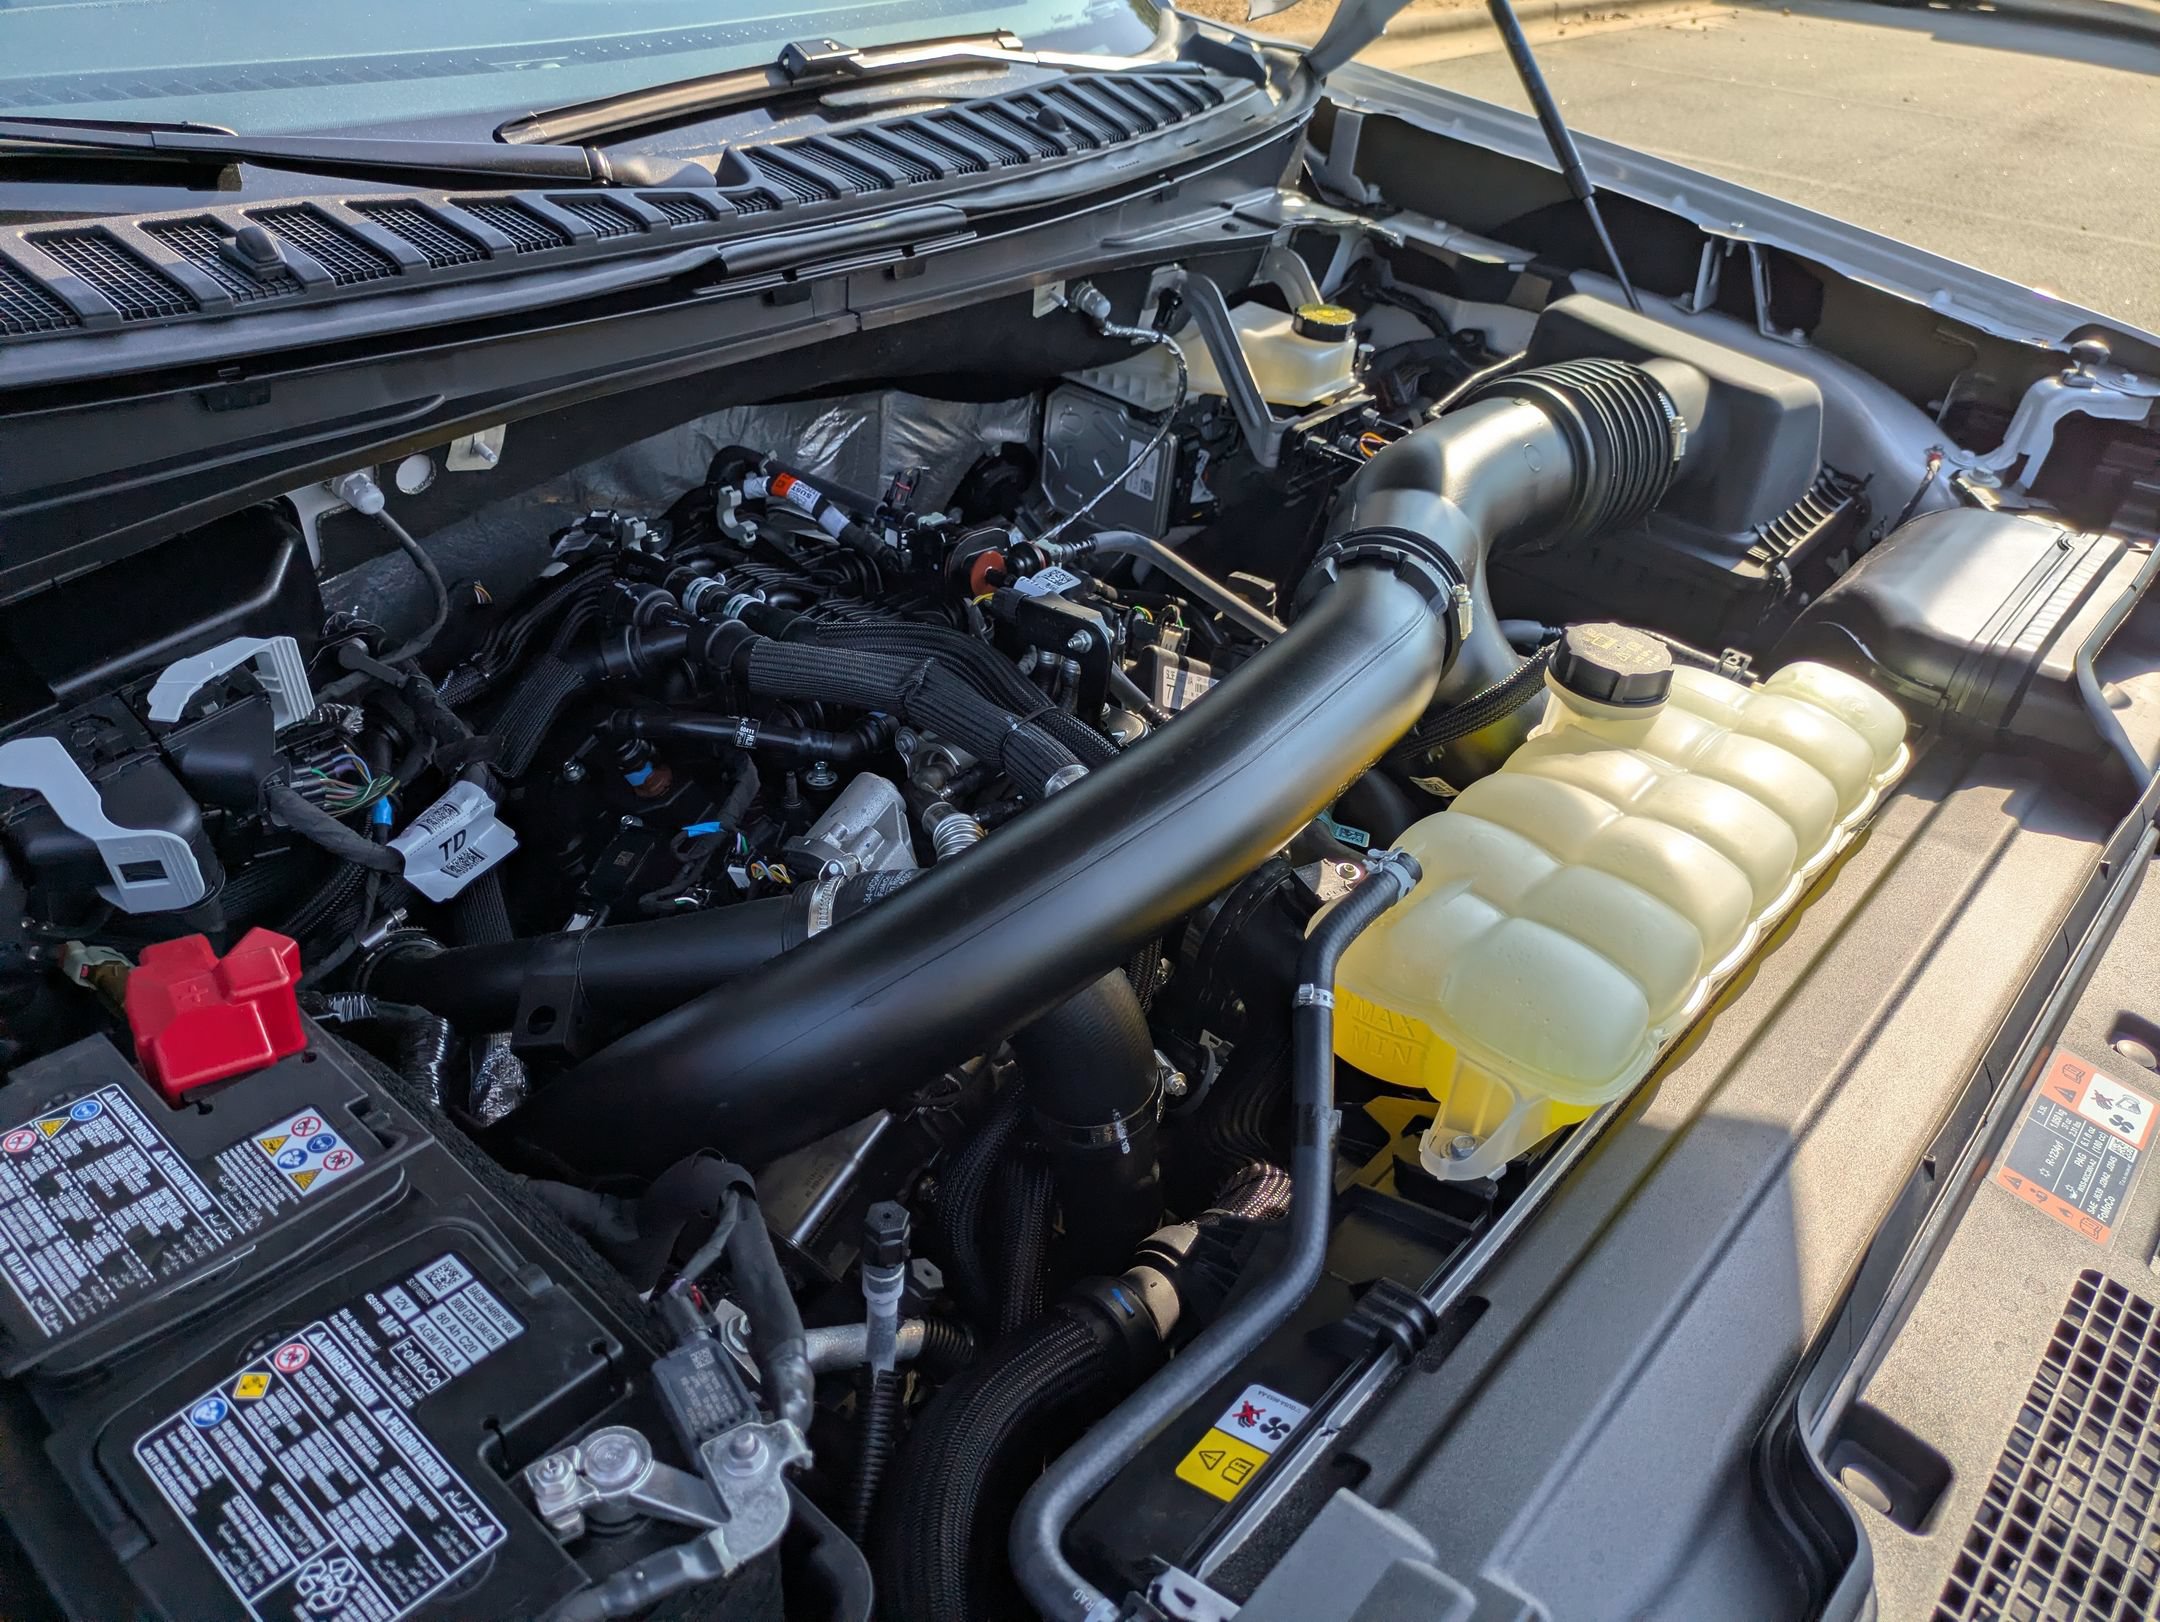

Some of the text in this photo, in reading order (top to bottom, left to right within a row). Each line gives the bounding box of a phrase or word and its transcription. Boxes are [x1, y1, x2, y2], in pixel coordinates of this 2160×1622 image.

[438, 829, 467, 861] TD
[1357, 999, 1417, 1038] MAX
[1352, 1025, 1413, 1065] MIN
[108, 1096, 159, 1148] DANGER/POISON
[158, 1156, 213, 1212] PELIGRO/VENENO
[2044, 1138, 2065, 1168] R-1234yf
[2096, 1193, 2115, 1223] FoMoCo
[395, 1339, 445, 1388] FoMoCo
[414, 1320, 463, 1368] AGM/VRLA
[315, 1338, 380, 1406] DANGER/POISON
[382, 1415, 452, 1489] PELIGRO/VENENO
[1073, 1589, 1095, 1611] RAD
